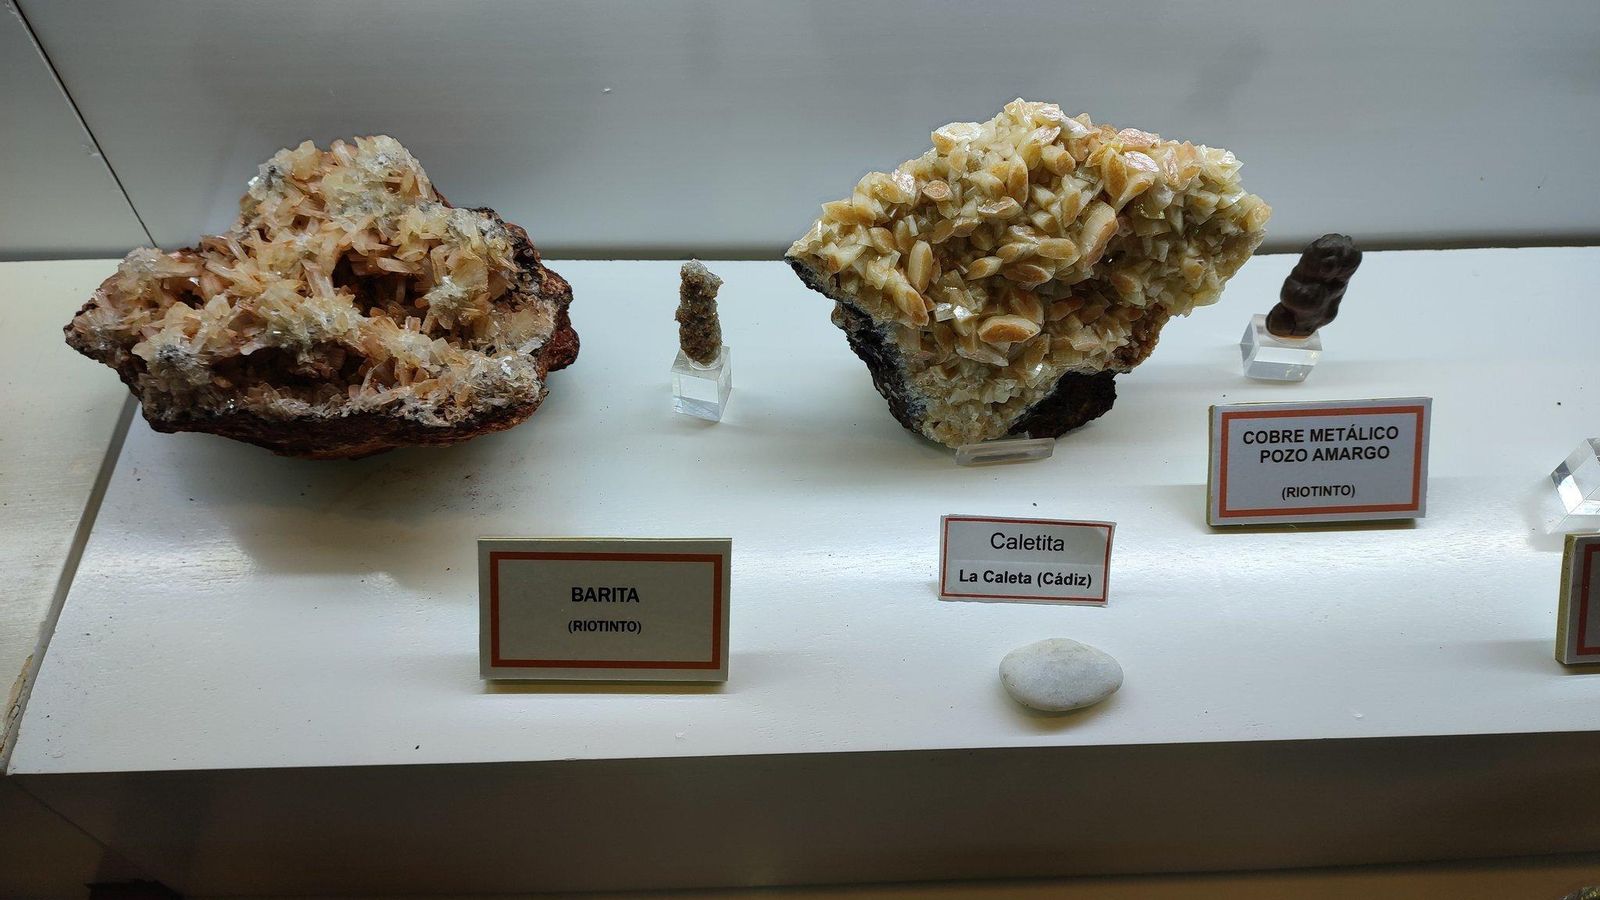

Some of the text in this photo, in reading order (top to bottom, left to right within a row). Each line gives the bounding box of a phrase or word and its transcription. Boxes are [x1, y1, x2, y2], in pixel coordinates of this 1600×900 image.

[1243, 424, 1399, 445] COBRE METÁLICO
[1260, 446, 1390, 463] POZO AMARGO
[1282, 485, 1356, 501] (RIOTINTO)
[991, 532, 1065, 552] Caletita
[960, 569, 1092, 589] La Caleta (Cádiz)
[572, 587, 640, 603] BARITA
[568, 620, 642, 635] (RIOTINTO)
